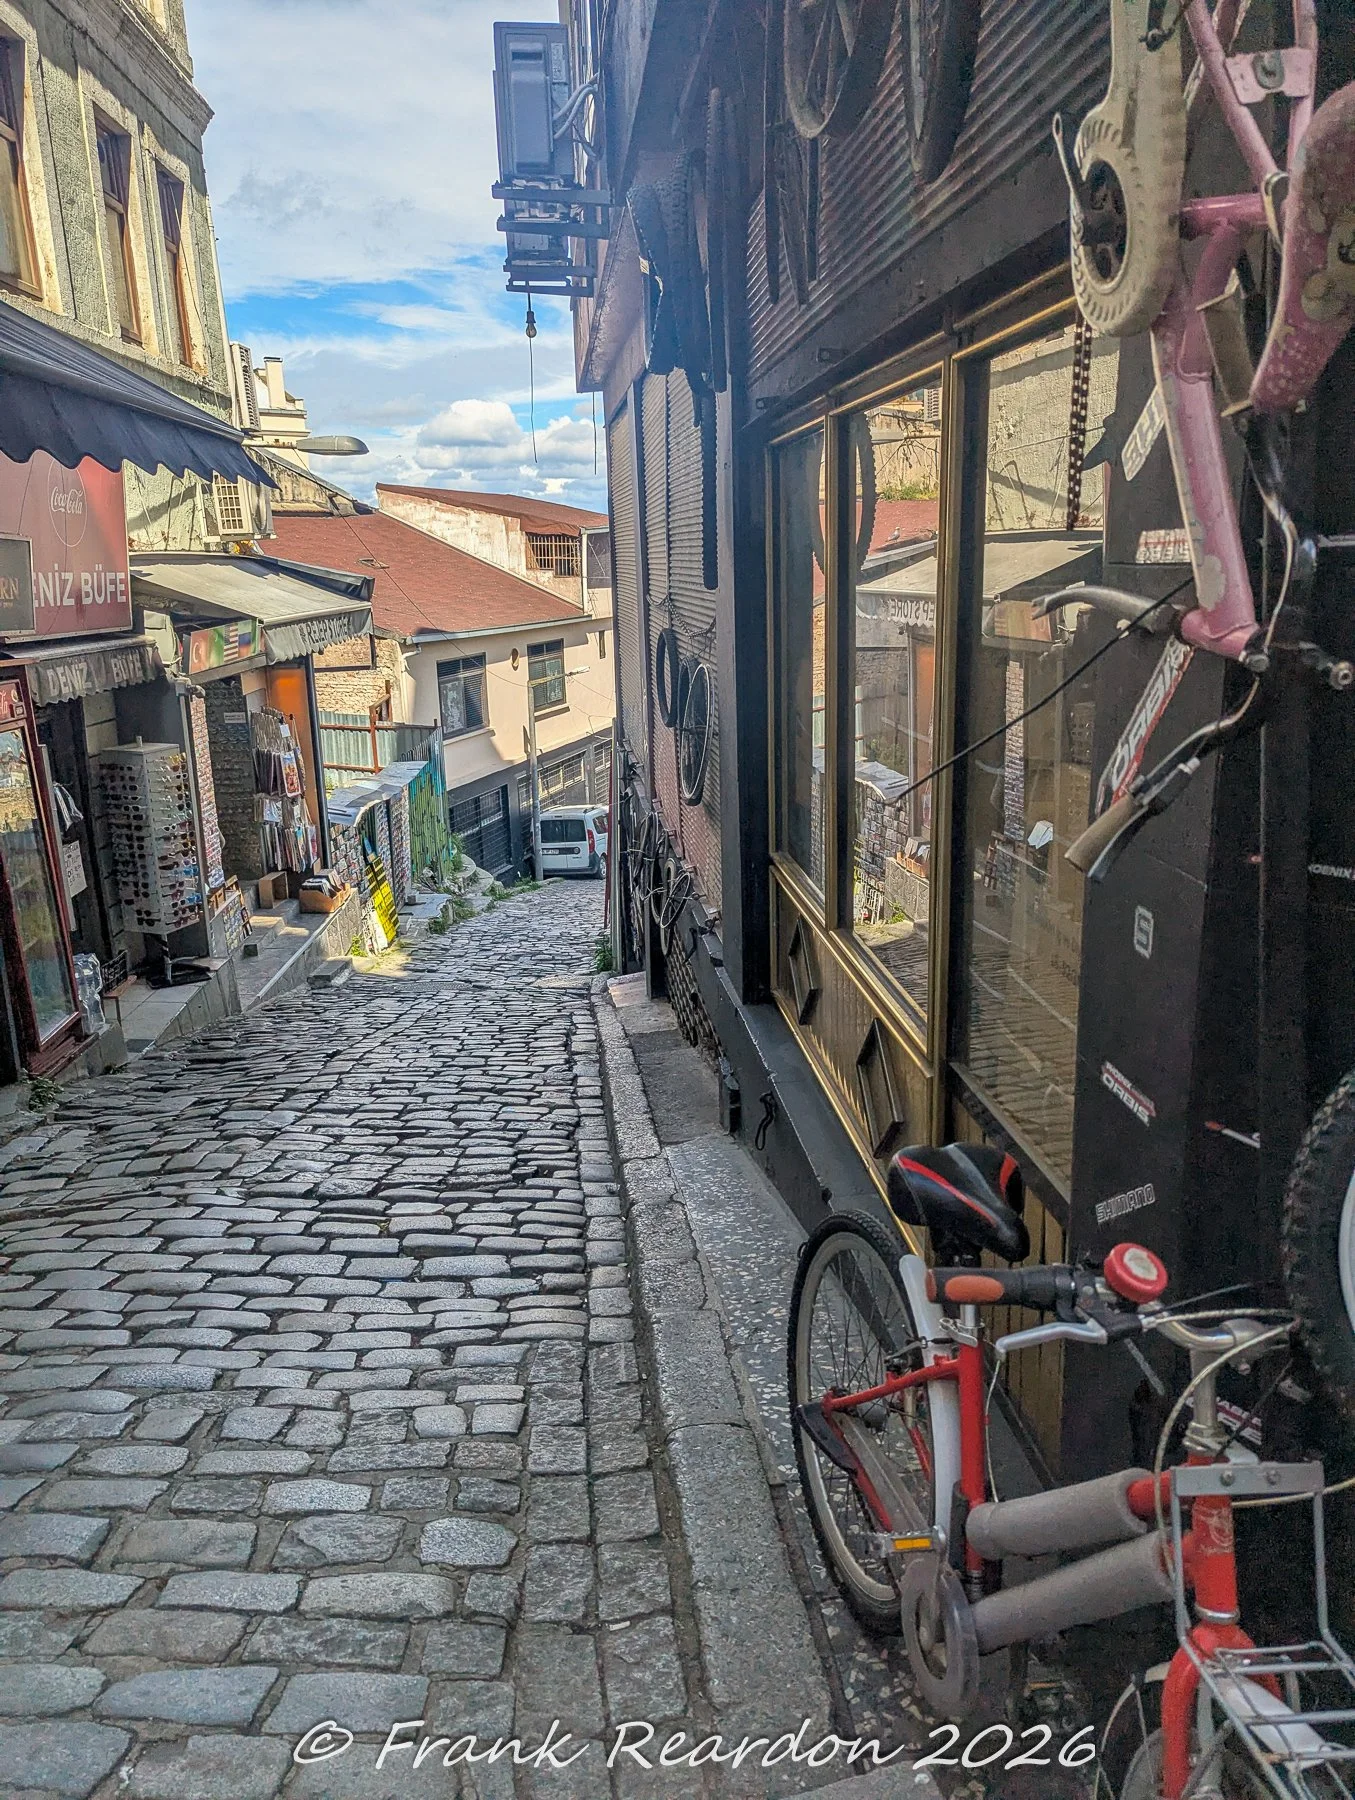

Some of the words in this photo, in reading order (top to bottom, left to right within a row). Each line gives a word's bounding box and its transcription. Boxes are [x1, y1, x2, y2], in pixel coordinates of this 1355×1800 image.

[33, 563, 75, 608] ENİZ
[80, 563, 127, 605] BÜFE
[1095, 1183, 1155, 1223] SHIMANO
